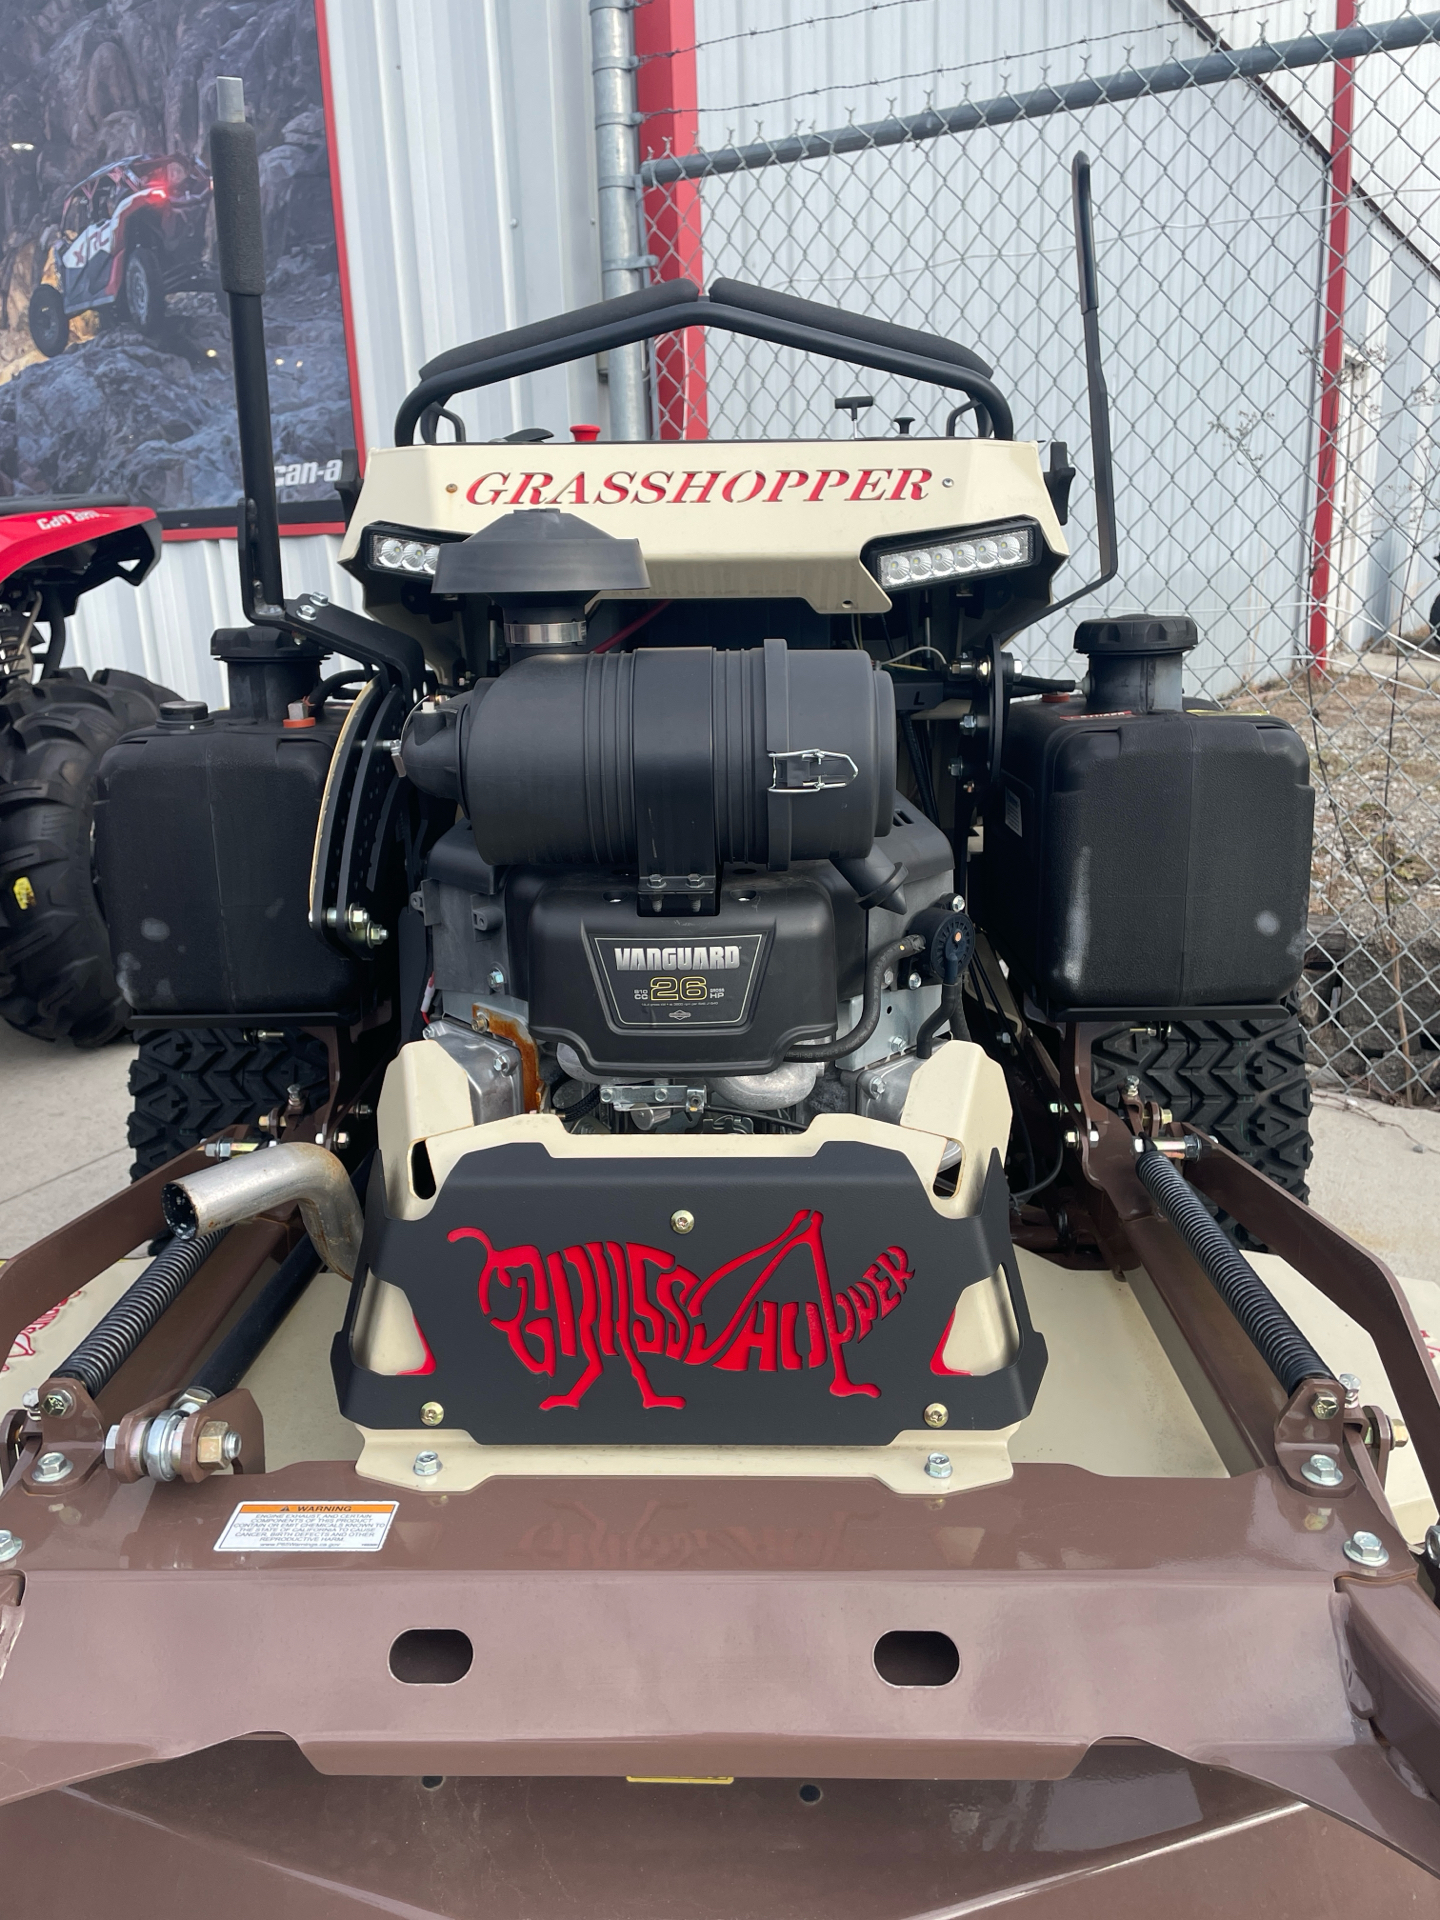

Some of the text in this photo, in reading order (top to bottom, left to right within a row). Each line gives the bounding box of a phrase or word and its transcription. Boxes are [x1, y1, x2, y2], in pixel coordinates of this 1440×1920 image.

[274, 459, 343, 487] can-a
[465, 467, 933, 505] GRASSHOPPER
[614, 945, 740, 971] VANGUARD
[650, 976, 708, 1001] 26
